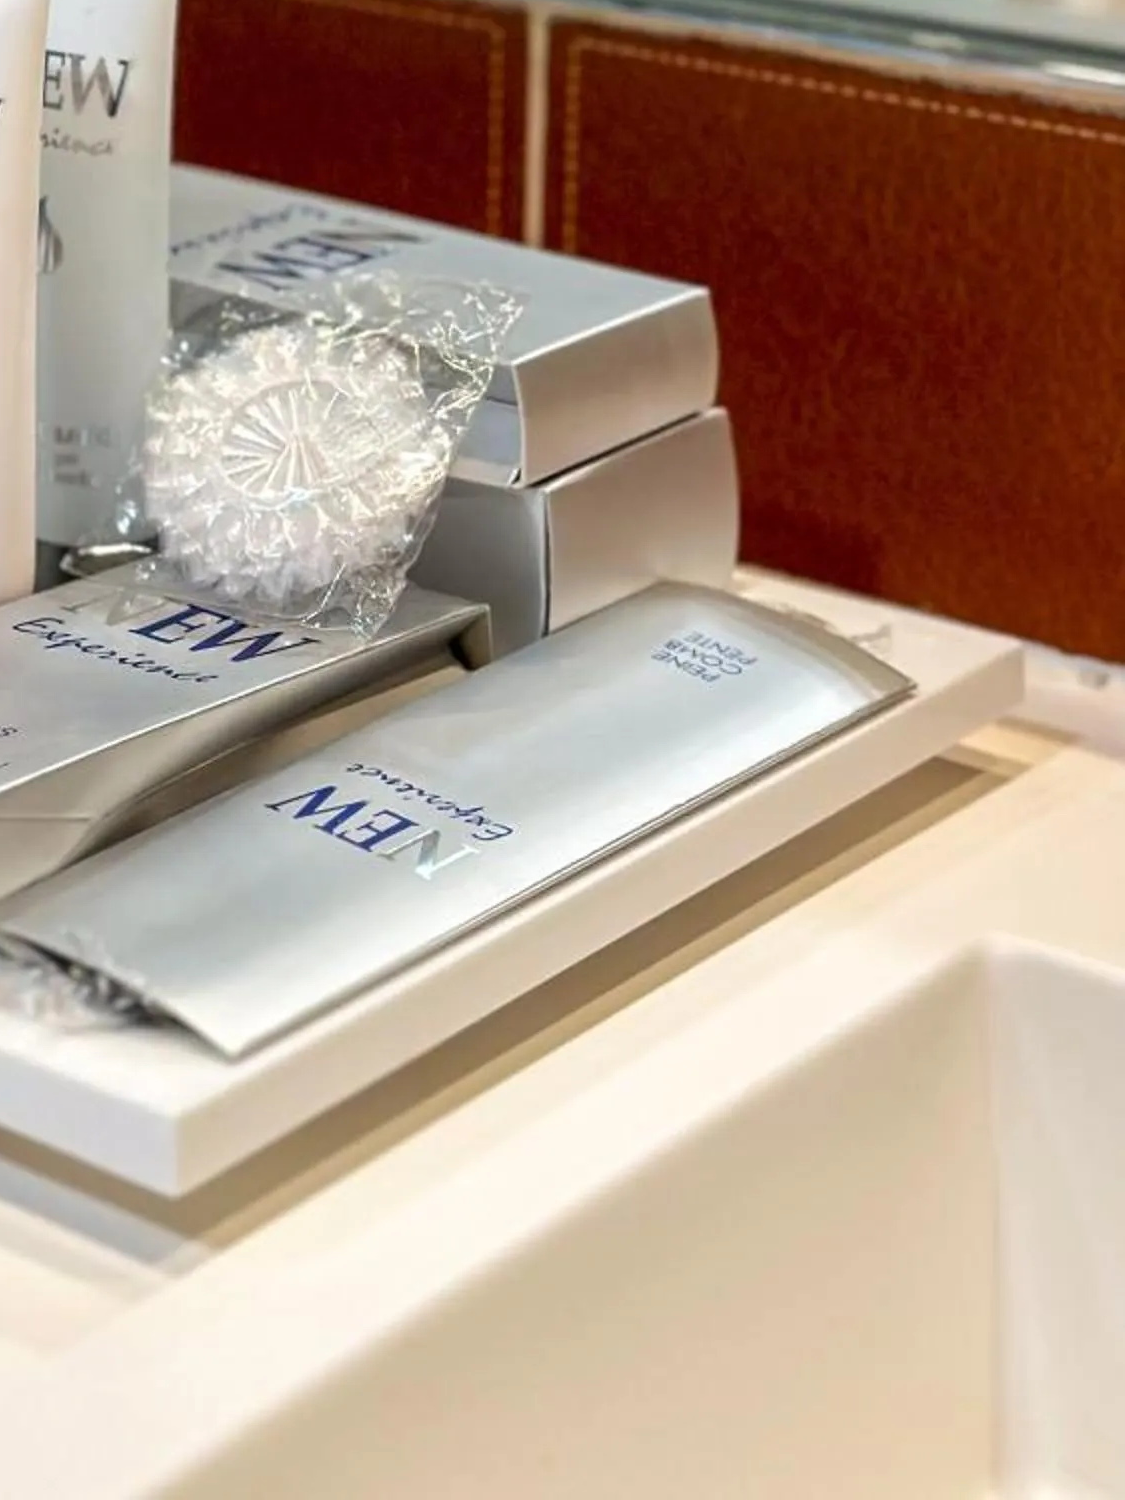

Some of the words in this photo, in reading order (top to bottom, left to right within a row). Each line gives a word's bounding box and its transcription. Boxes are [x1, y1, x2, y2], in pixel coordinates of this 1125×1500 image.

[42, 49, 131, 118] EW
[39, 128, 114, 157] rience
[12, 616, 219, 683] Experience
[59, 589, 322, 663] NEW
[263, 784, 481, 880] NEW
[345, 762, 515, 842] Experience
